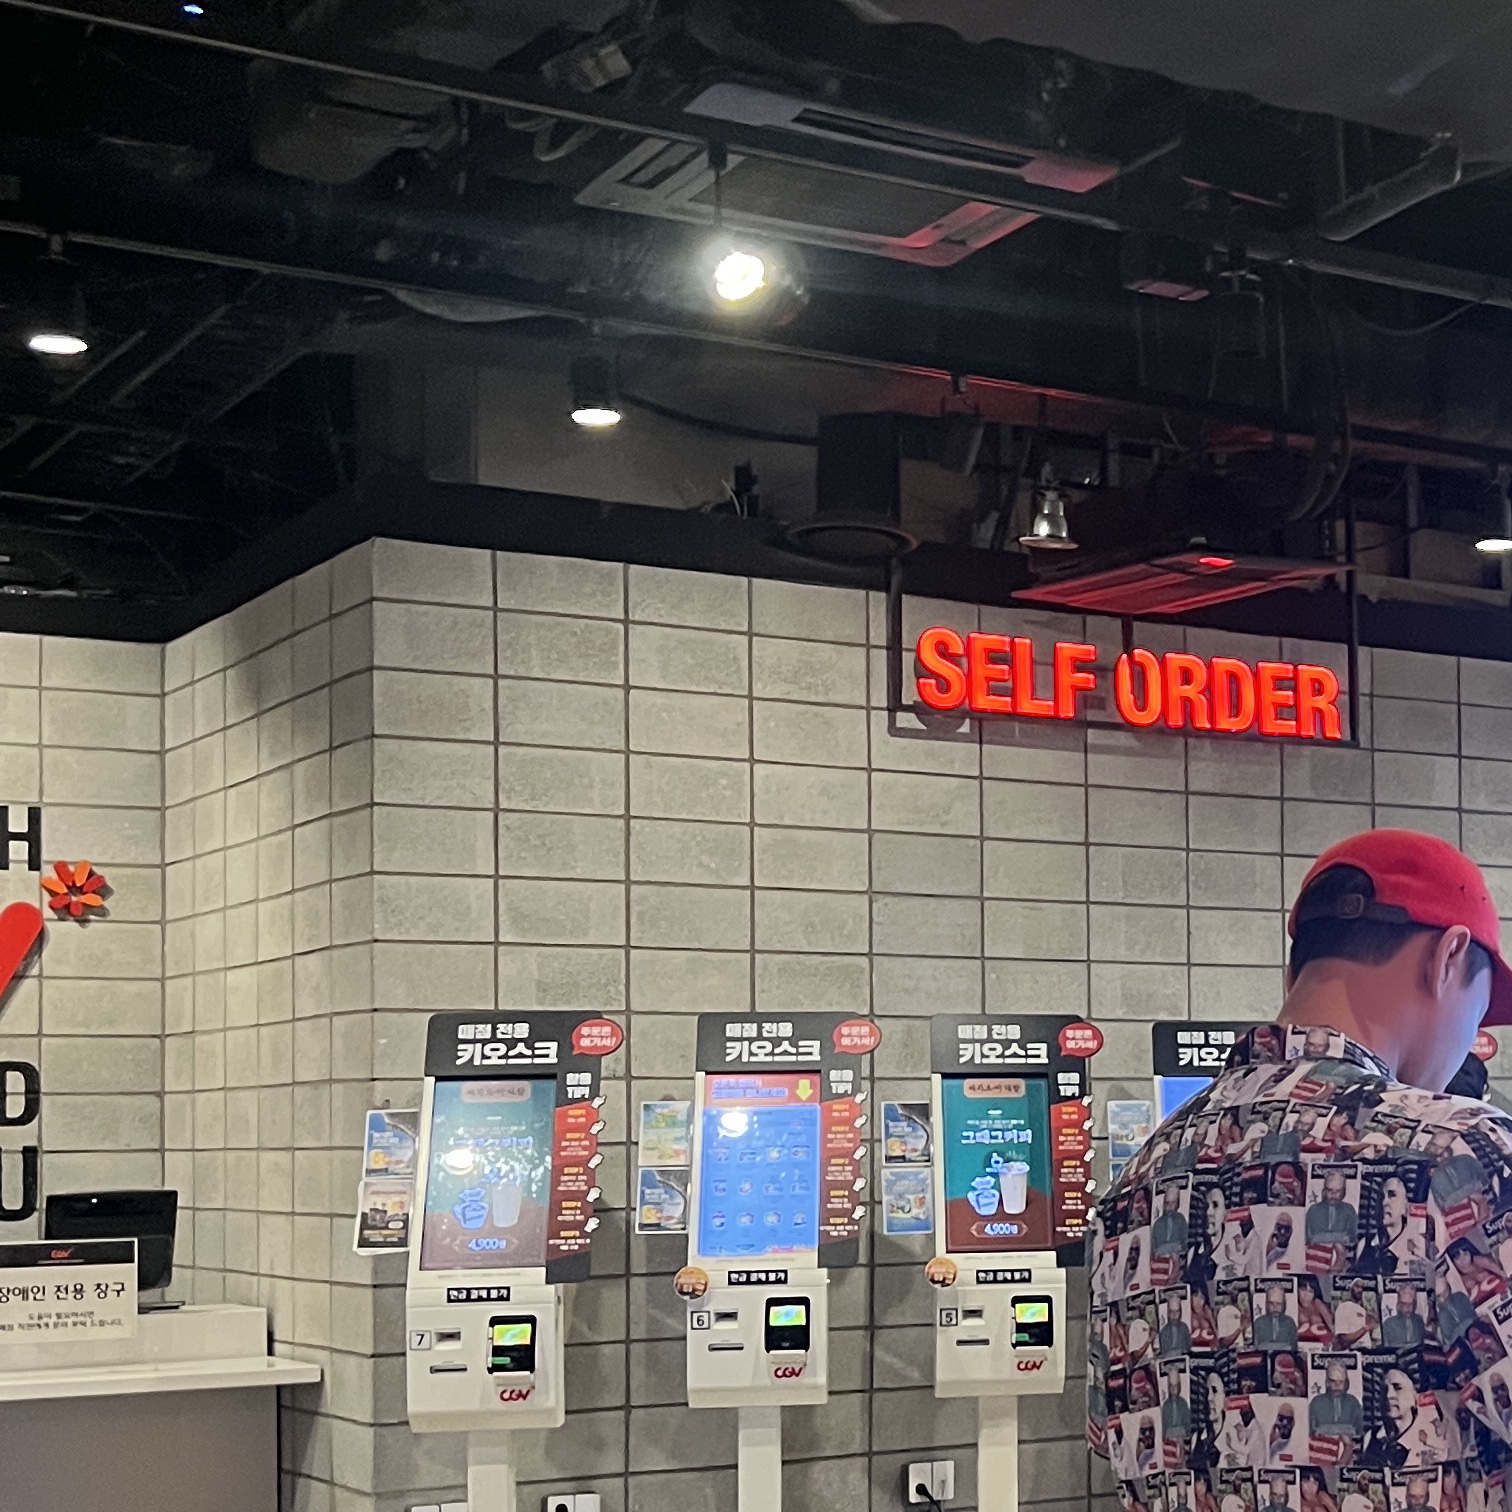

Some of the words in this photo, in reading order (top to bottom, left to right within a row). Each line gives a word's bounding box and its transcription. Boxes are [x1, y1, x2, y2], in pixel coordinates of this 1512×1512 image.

[917, 627, 1096, 719] SELF
[1114, 648, 1342, 740] ORDER
[456, 1042, 559, 1066] 키오스크
[725, 1040, 821, 1062] 키오스크
[959, 1043, 1049, 1064] 키오스크
[54, 1282, 85, 1301] 전용
[696, 1315, 704, 1326] 6
[945, 1312, 953, 1323] 5
[416, 1334, 425, 1346] 7
[1017, 1360, 1044, 1371] CGV
[774, 1367, 802, 1378] CGV
[500, 1389, 531, 1401] CGV
